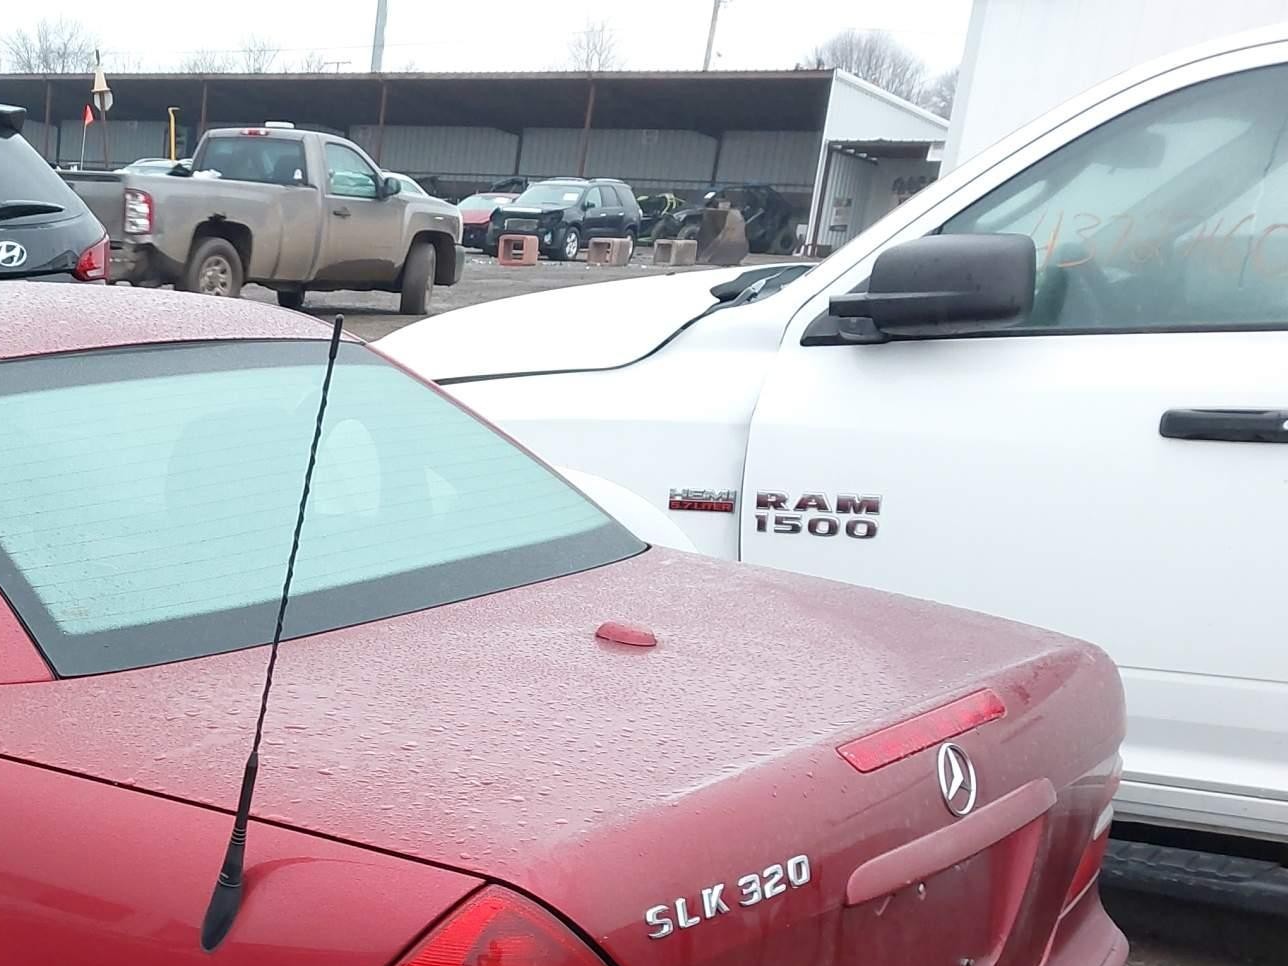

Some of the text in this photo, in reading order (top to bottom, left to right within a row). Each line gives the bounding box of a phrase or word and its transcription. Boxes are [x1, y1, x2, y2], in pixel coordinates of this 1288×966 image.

[669, 488, 738, 501] HEMI
[756, 489, 883, 516] RAM
[755, 511, 879, 540] 1500
[644, 854, 812, 940] SLK 320
